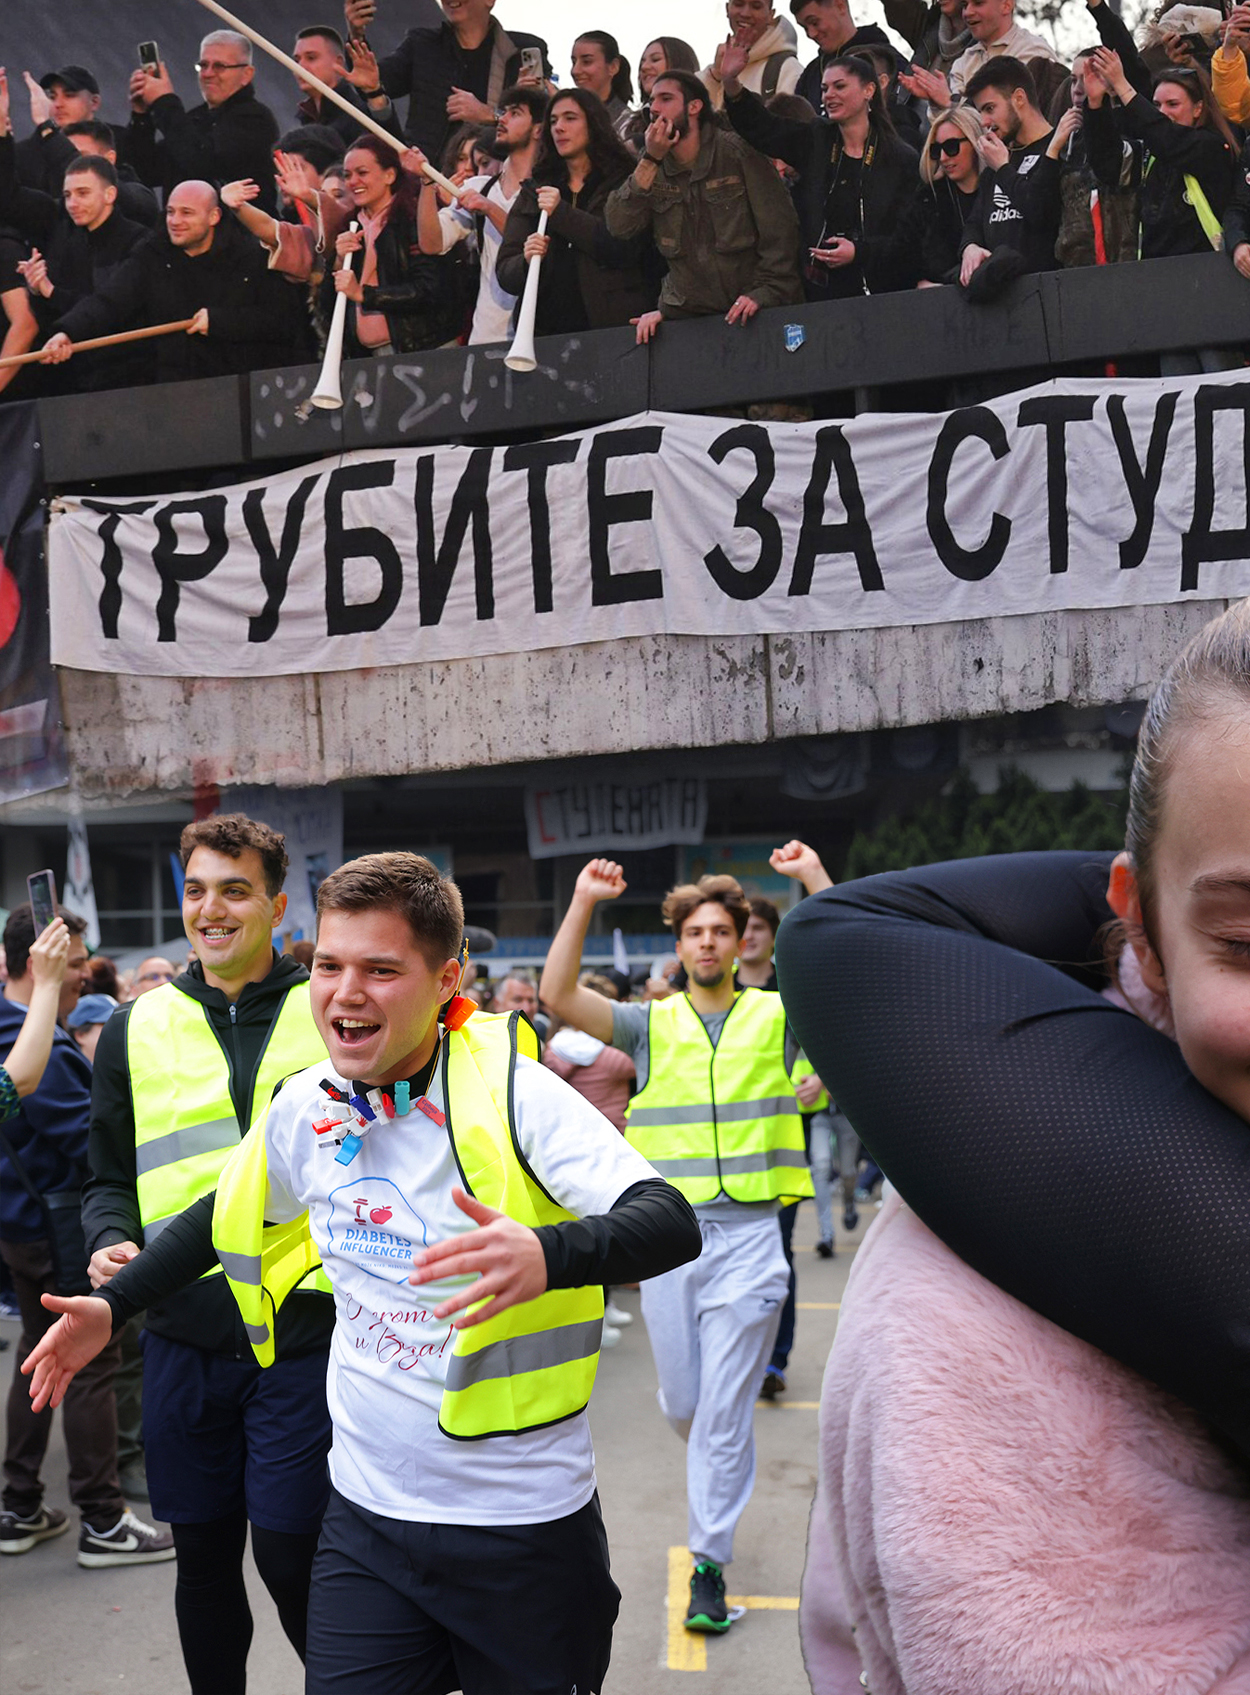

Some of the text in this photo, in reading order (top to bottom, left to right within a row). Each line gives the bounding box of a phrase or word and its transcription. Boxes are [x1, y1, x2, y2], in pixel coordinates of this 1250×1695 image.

[81, 427, 665, 643] ТРУБИТЕ
[703, 423, 885, 600] ЗА
[345, 1228, 412, 1248] DIABETES
[339, 1241, 412, 1260] INFLUENCER
